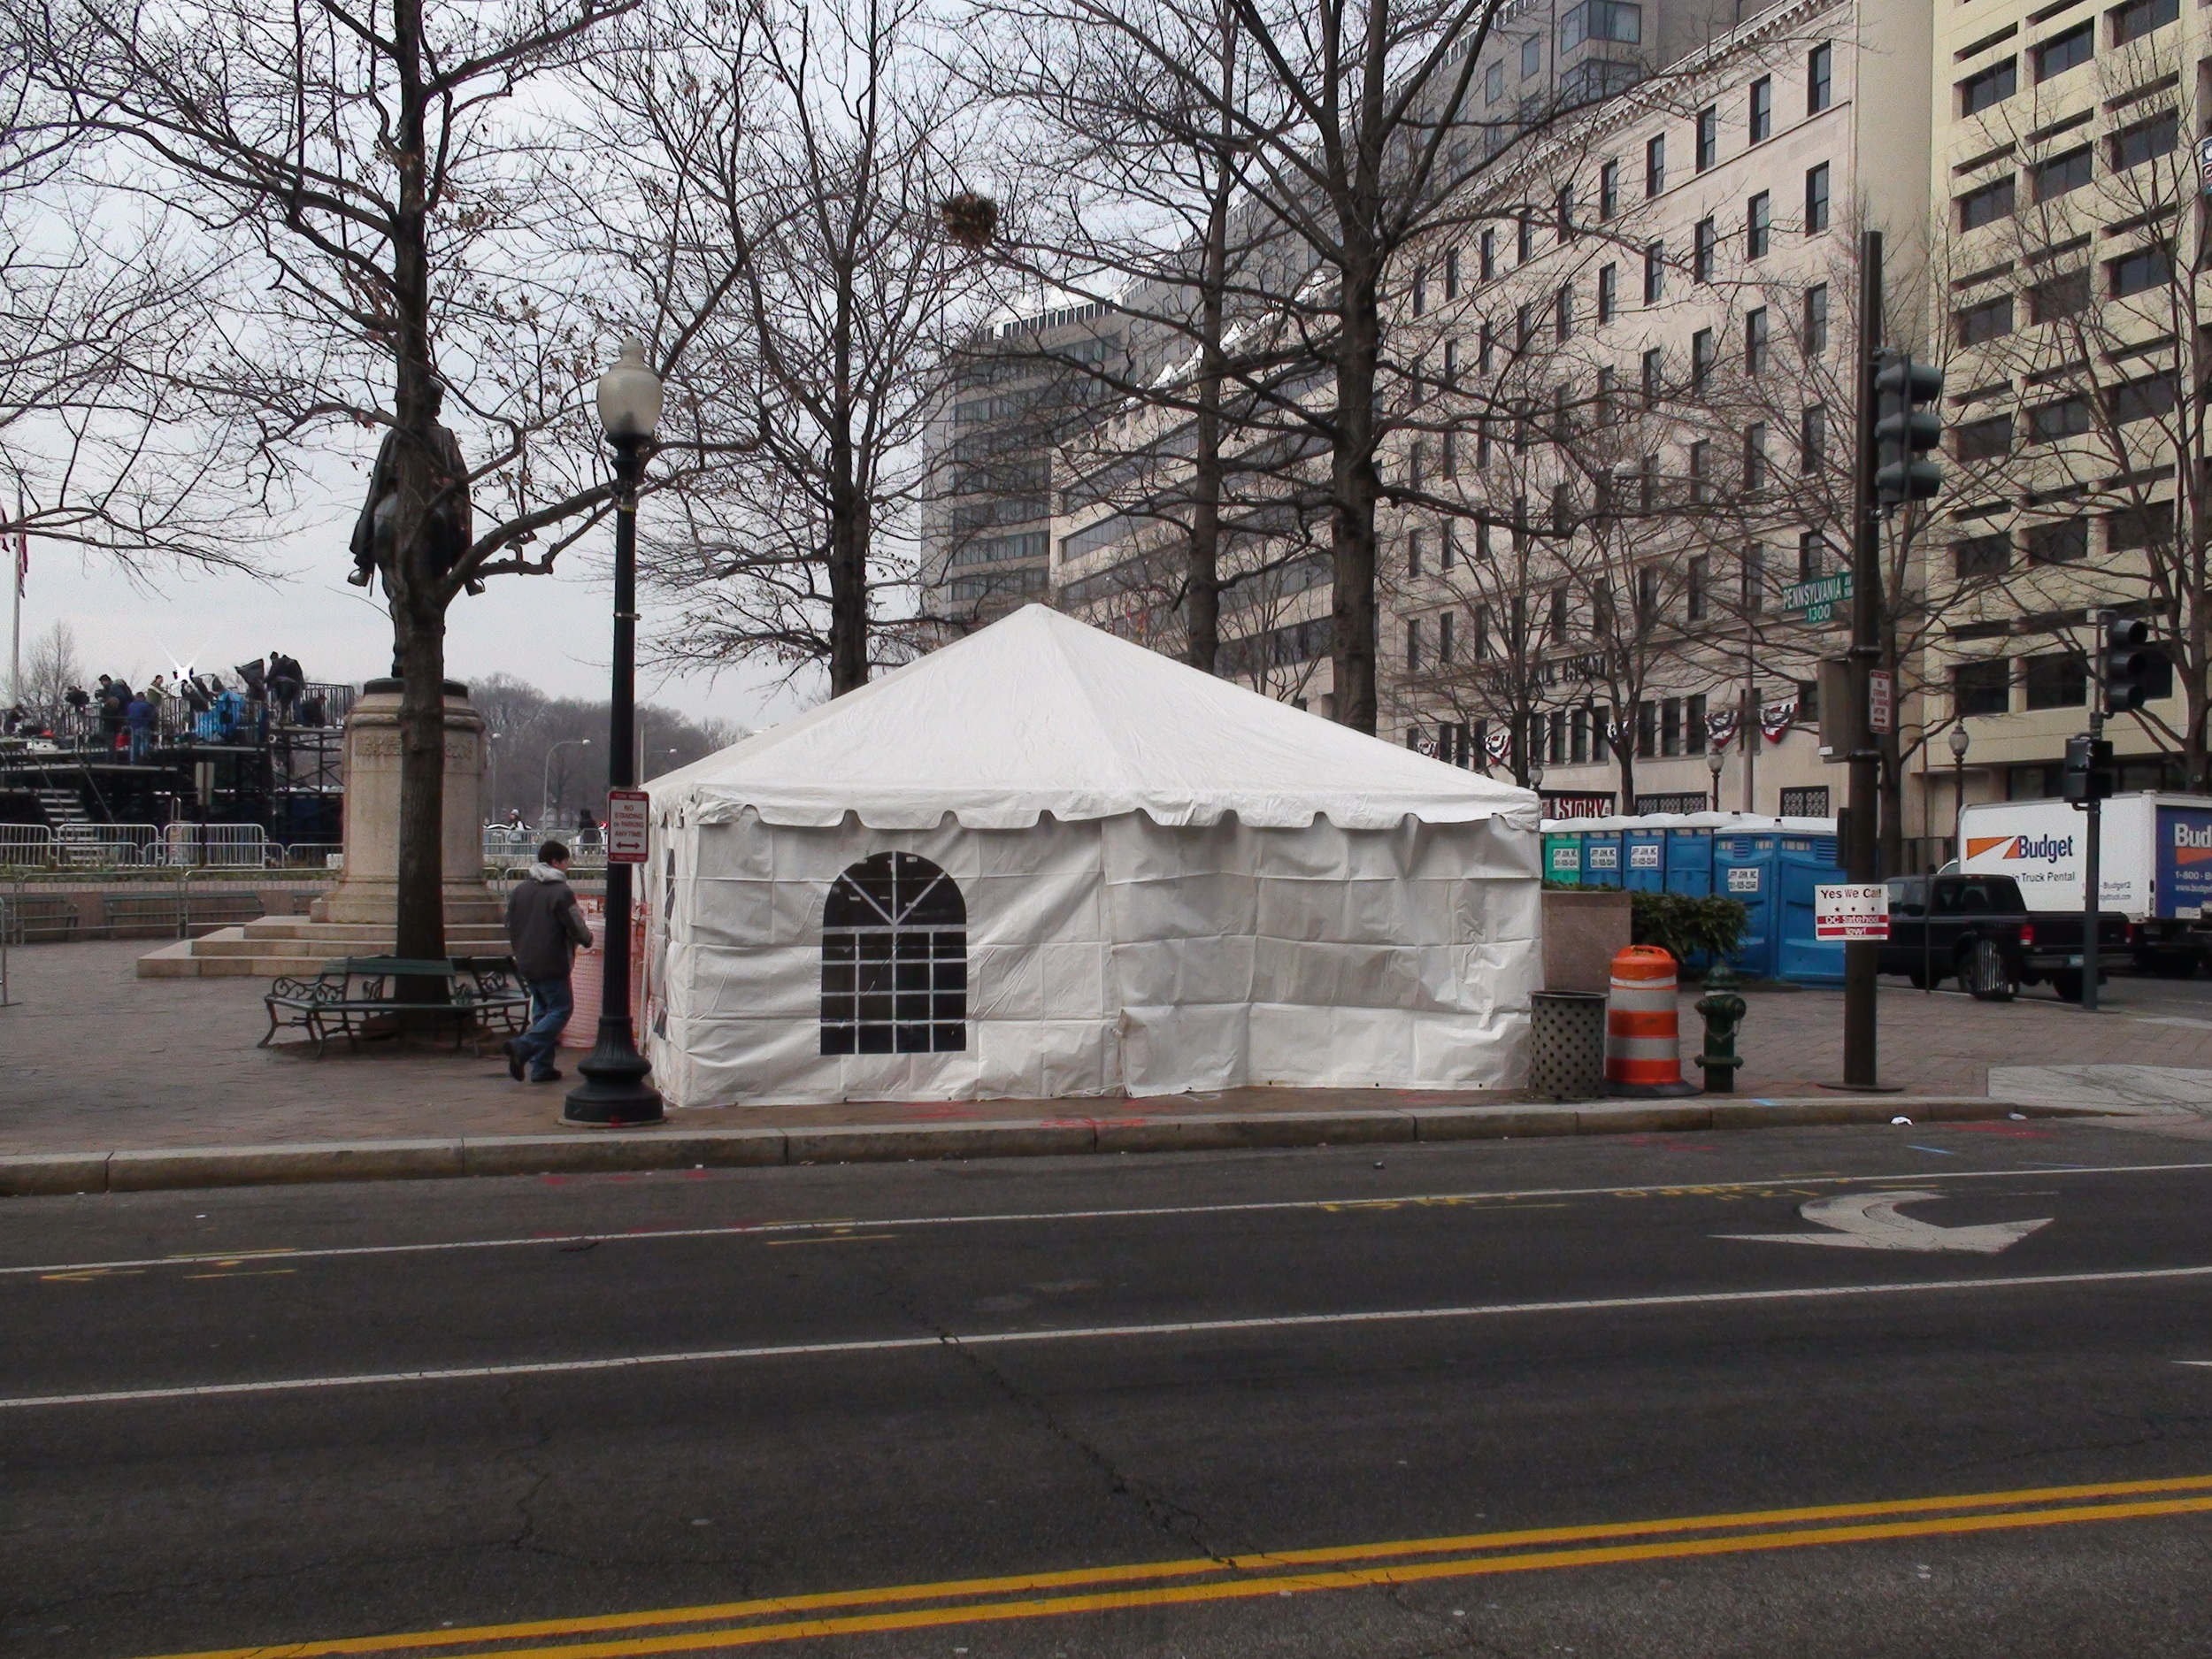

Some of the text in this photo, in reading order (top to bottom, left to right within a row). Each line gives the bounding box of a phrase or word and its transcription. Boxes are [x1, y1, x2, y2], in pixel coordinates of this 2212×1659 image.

[1783, 577, 1841, 610] PENNSYLVANIA
[1808, 604, 1831, 621] 1300
[1559, 798, 1606, 818] STORY
[2174, 822, 2212, 848] Bud
[2017, 833, 2073, 864] Budget
[2021, 872, 2045, 882] Truck
[1820, 889, 1842, 899] Yes
[1844, 889, 1859, 898] We
[1825, 915, 1839, 925] DC
